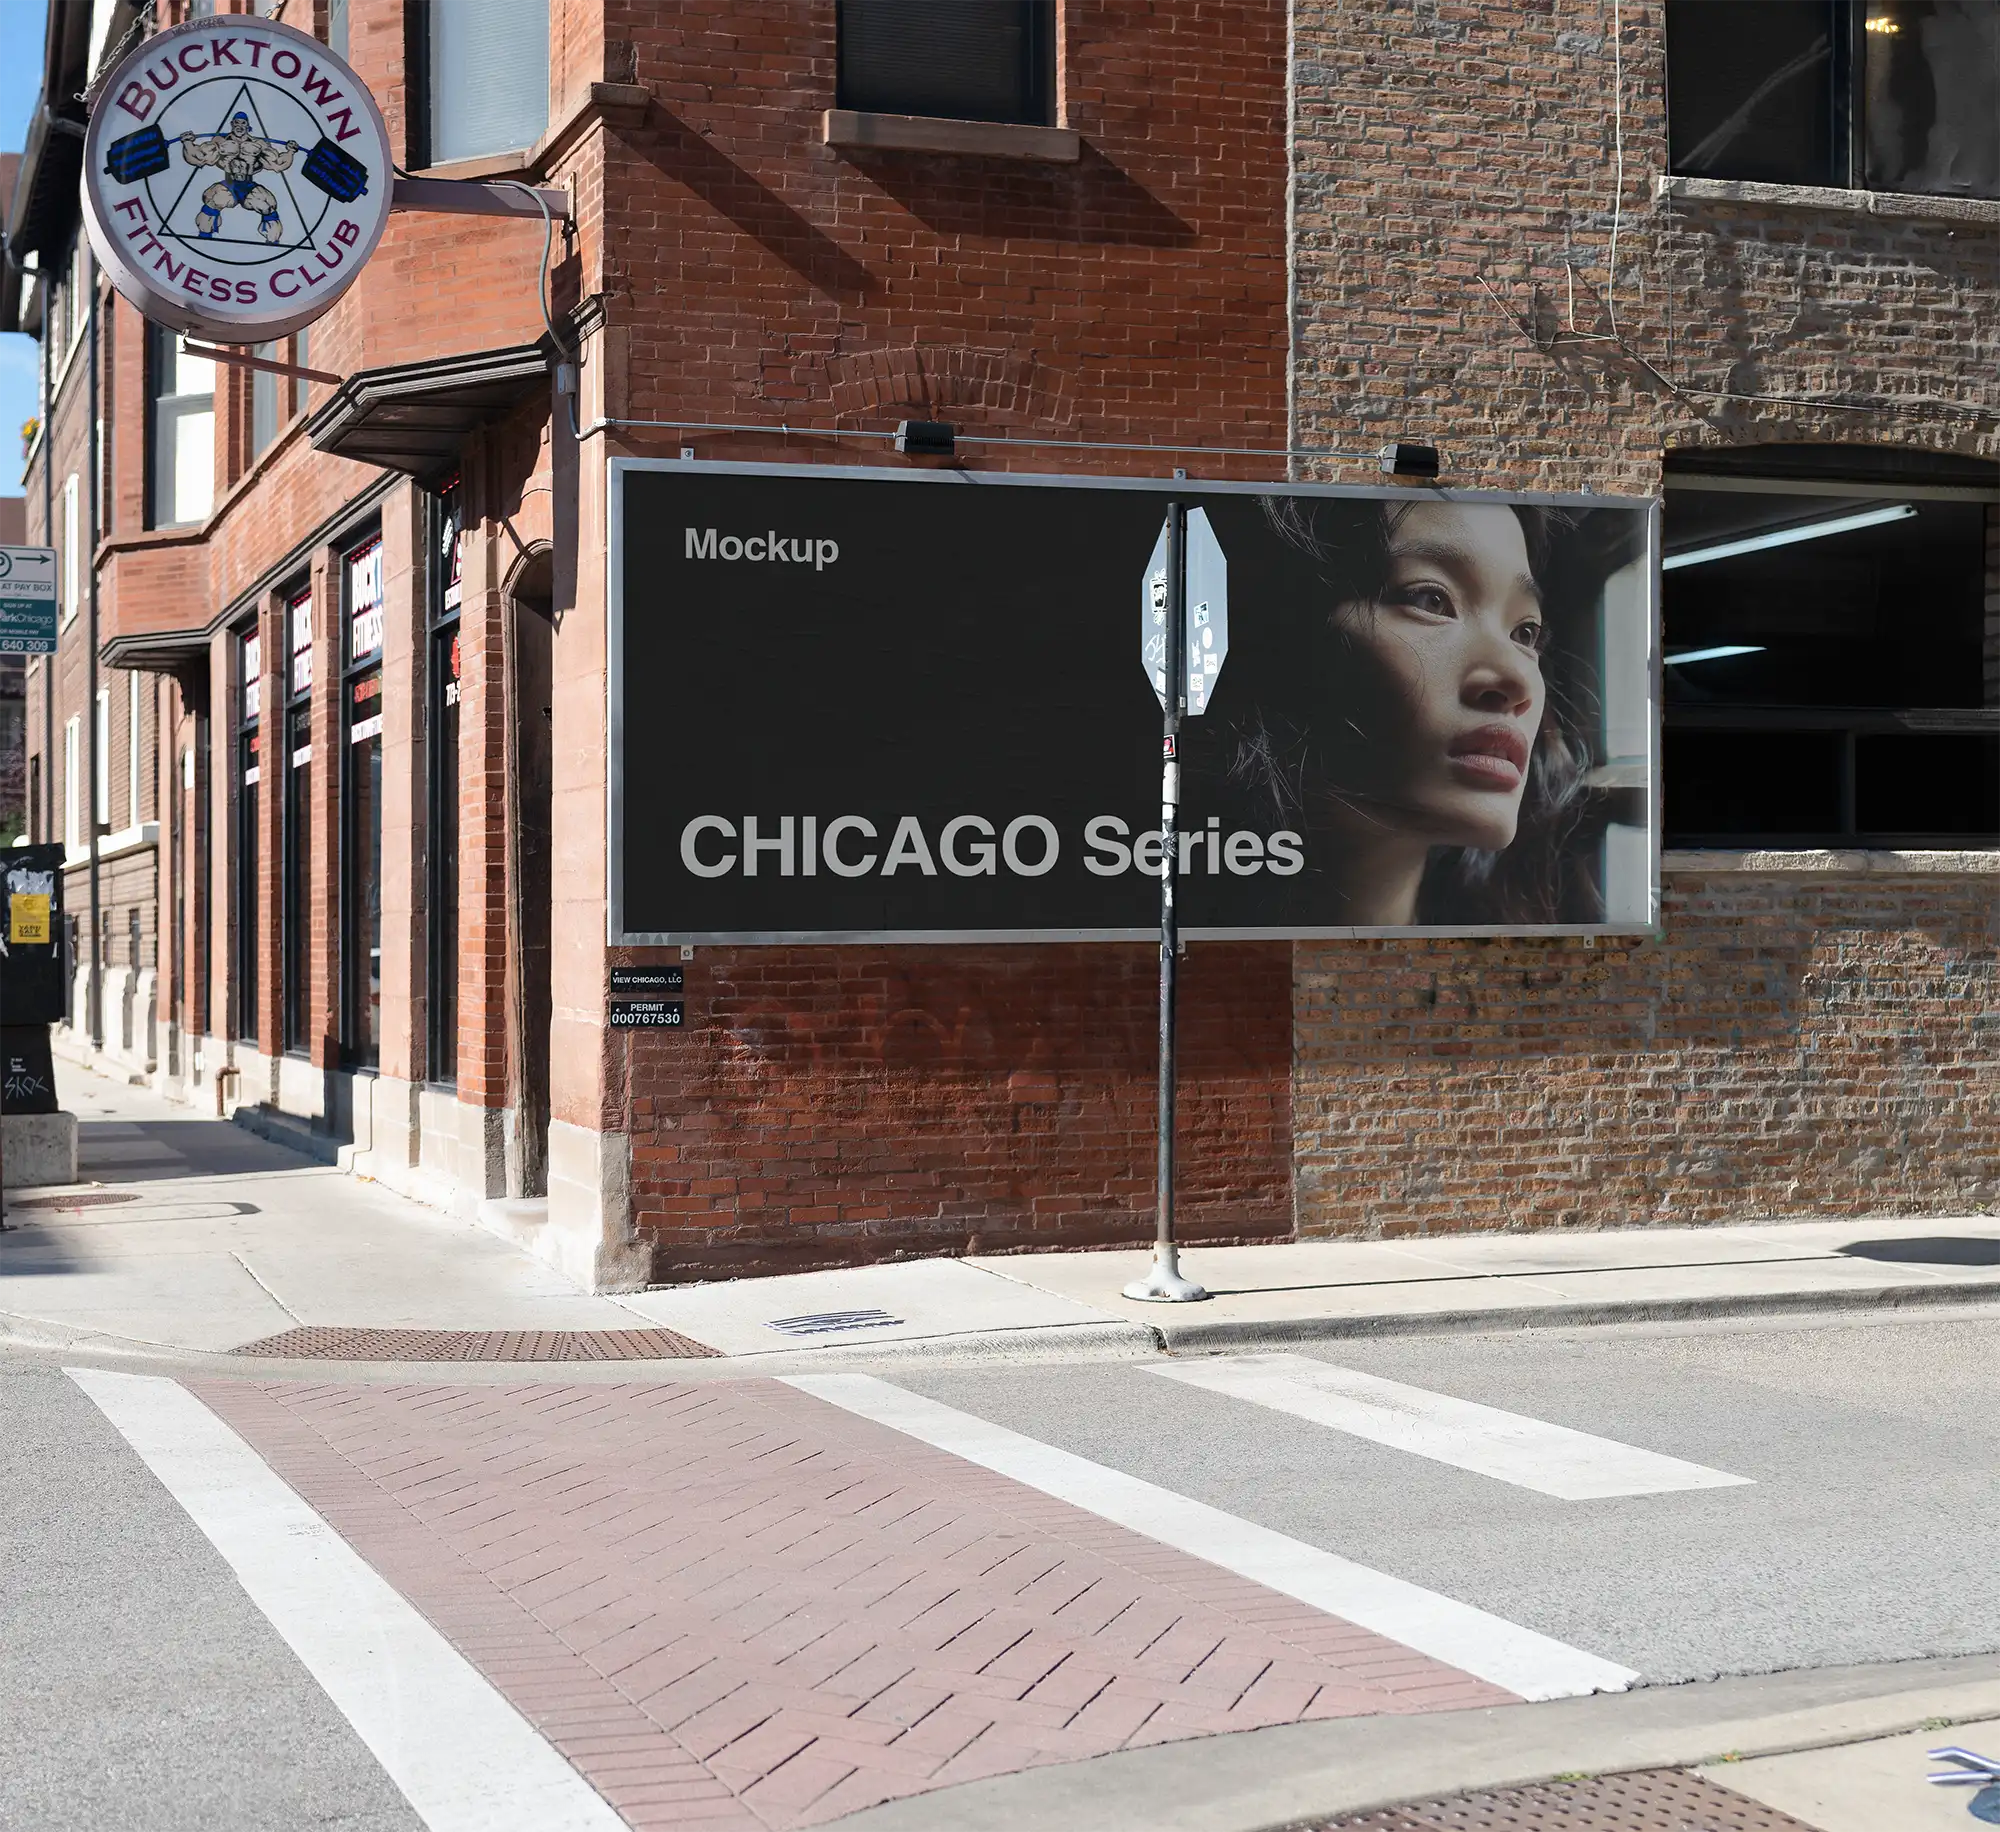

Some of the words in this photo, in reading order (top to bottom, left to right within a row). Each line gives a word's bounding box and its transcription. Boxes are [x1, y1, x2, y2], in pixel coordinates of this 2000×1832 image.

[116, 38, 361, 142] BUCKTOWN
[114, 197, 257, 304] FITNESS
[269, 219, 361, 298] CLUB
[686, 527, 839, 571] Mockup
[1, 582, 12, 590] AT
[14, 583, 31, 591] PAY
[33, 584, 53, 592] BOX
[1, 640, 24, 651] 640
[26, 641, 49, 652] 309
[681, 814, 1060, 878] CHICAGO
[1083, 815, 1305, 877] Series
[612, 976, 631, 984] VIEW
[631, 976, 667, 985] CHICAGO,
[668, 976, 682, 984] LLC
[630, 1003, 665, 1012] PERMIT
[611, 1013, 681, 1025] 000767530
